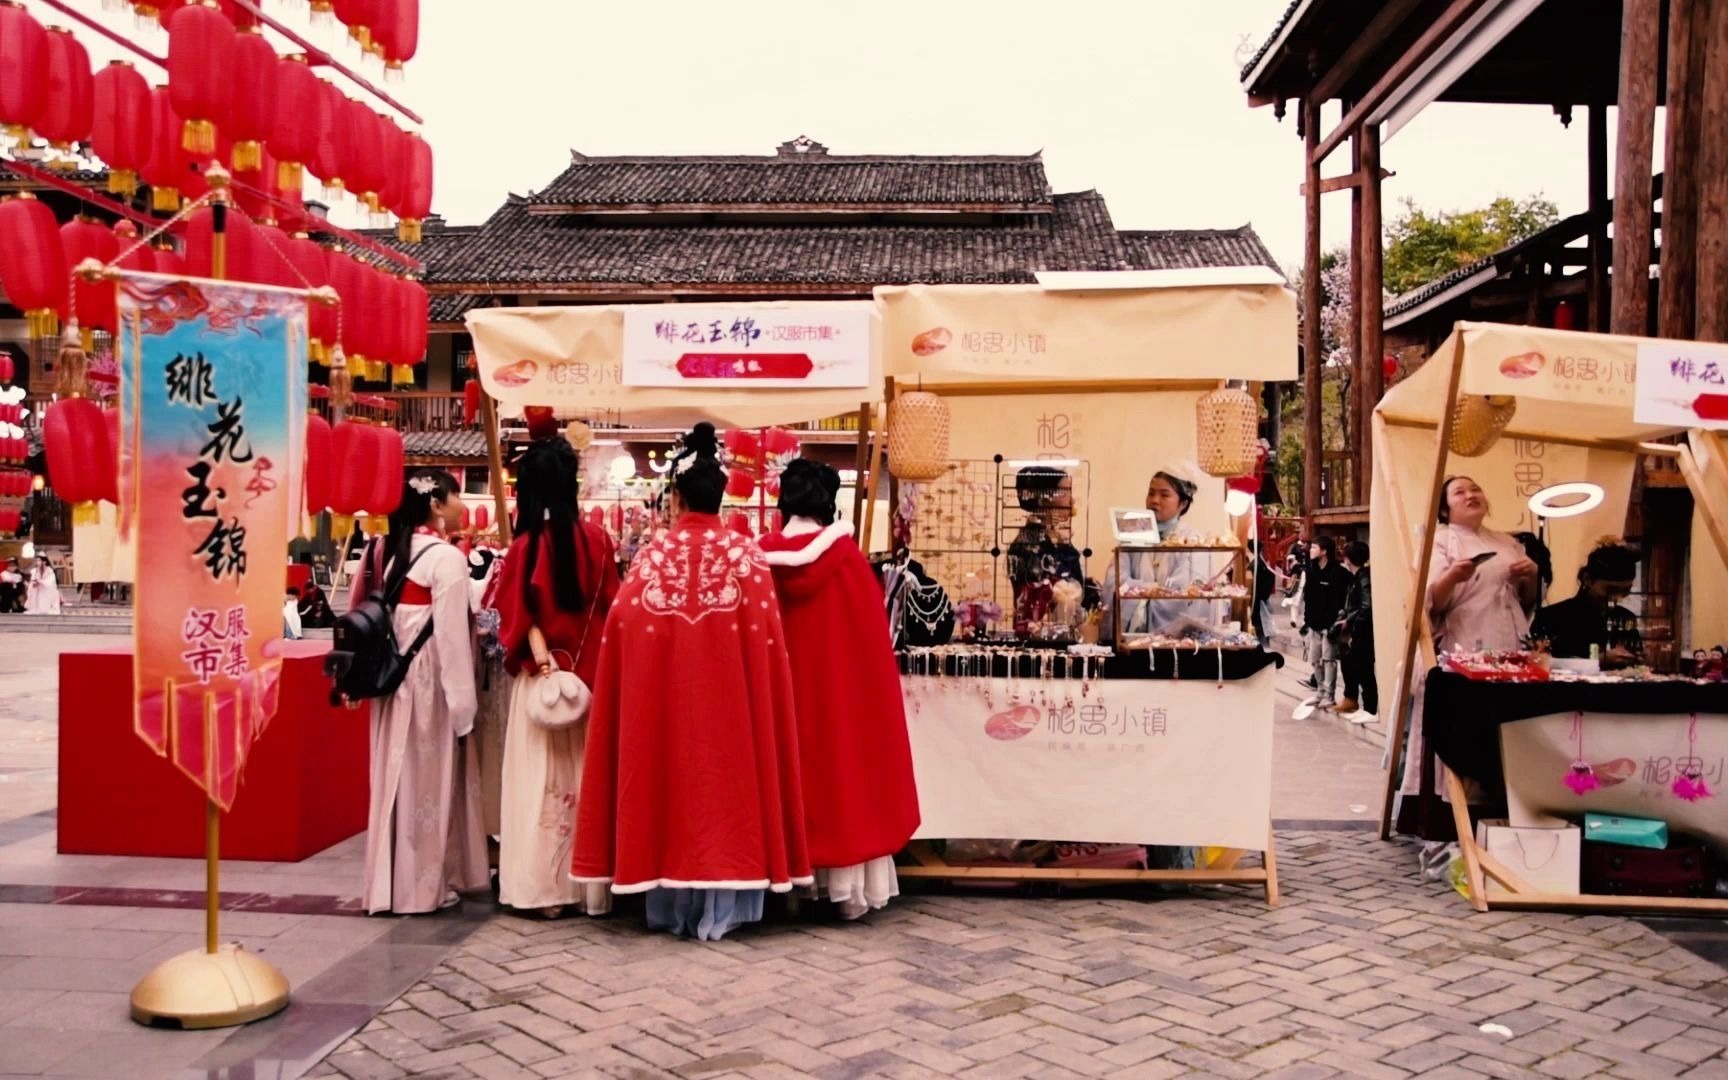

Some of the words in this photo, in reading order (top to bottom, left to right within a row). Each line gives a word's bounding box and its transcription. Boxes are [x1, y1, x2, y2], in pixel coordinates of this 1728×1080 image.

[655, 316, 761, 347] 绯花玉锦
[961, 331, 1046, 354] 相思小镇
[165, 352, 253, 587] 绯花玉锦
[1048, 704, 1168, 736] 相思小镇
